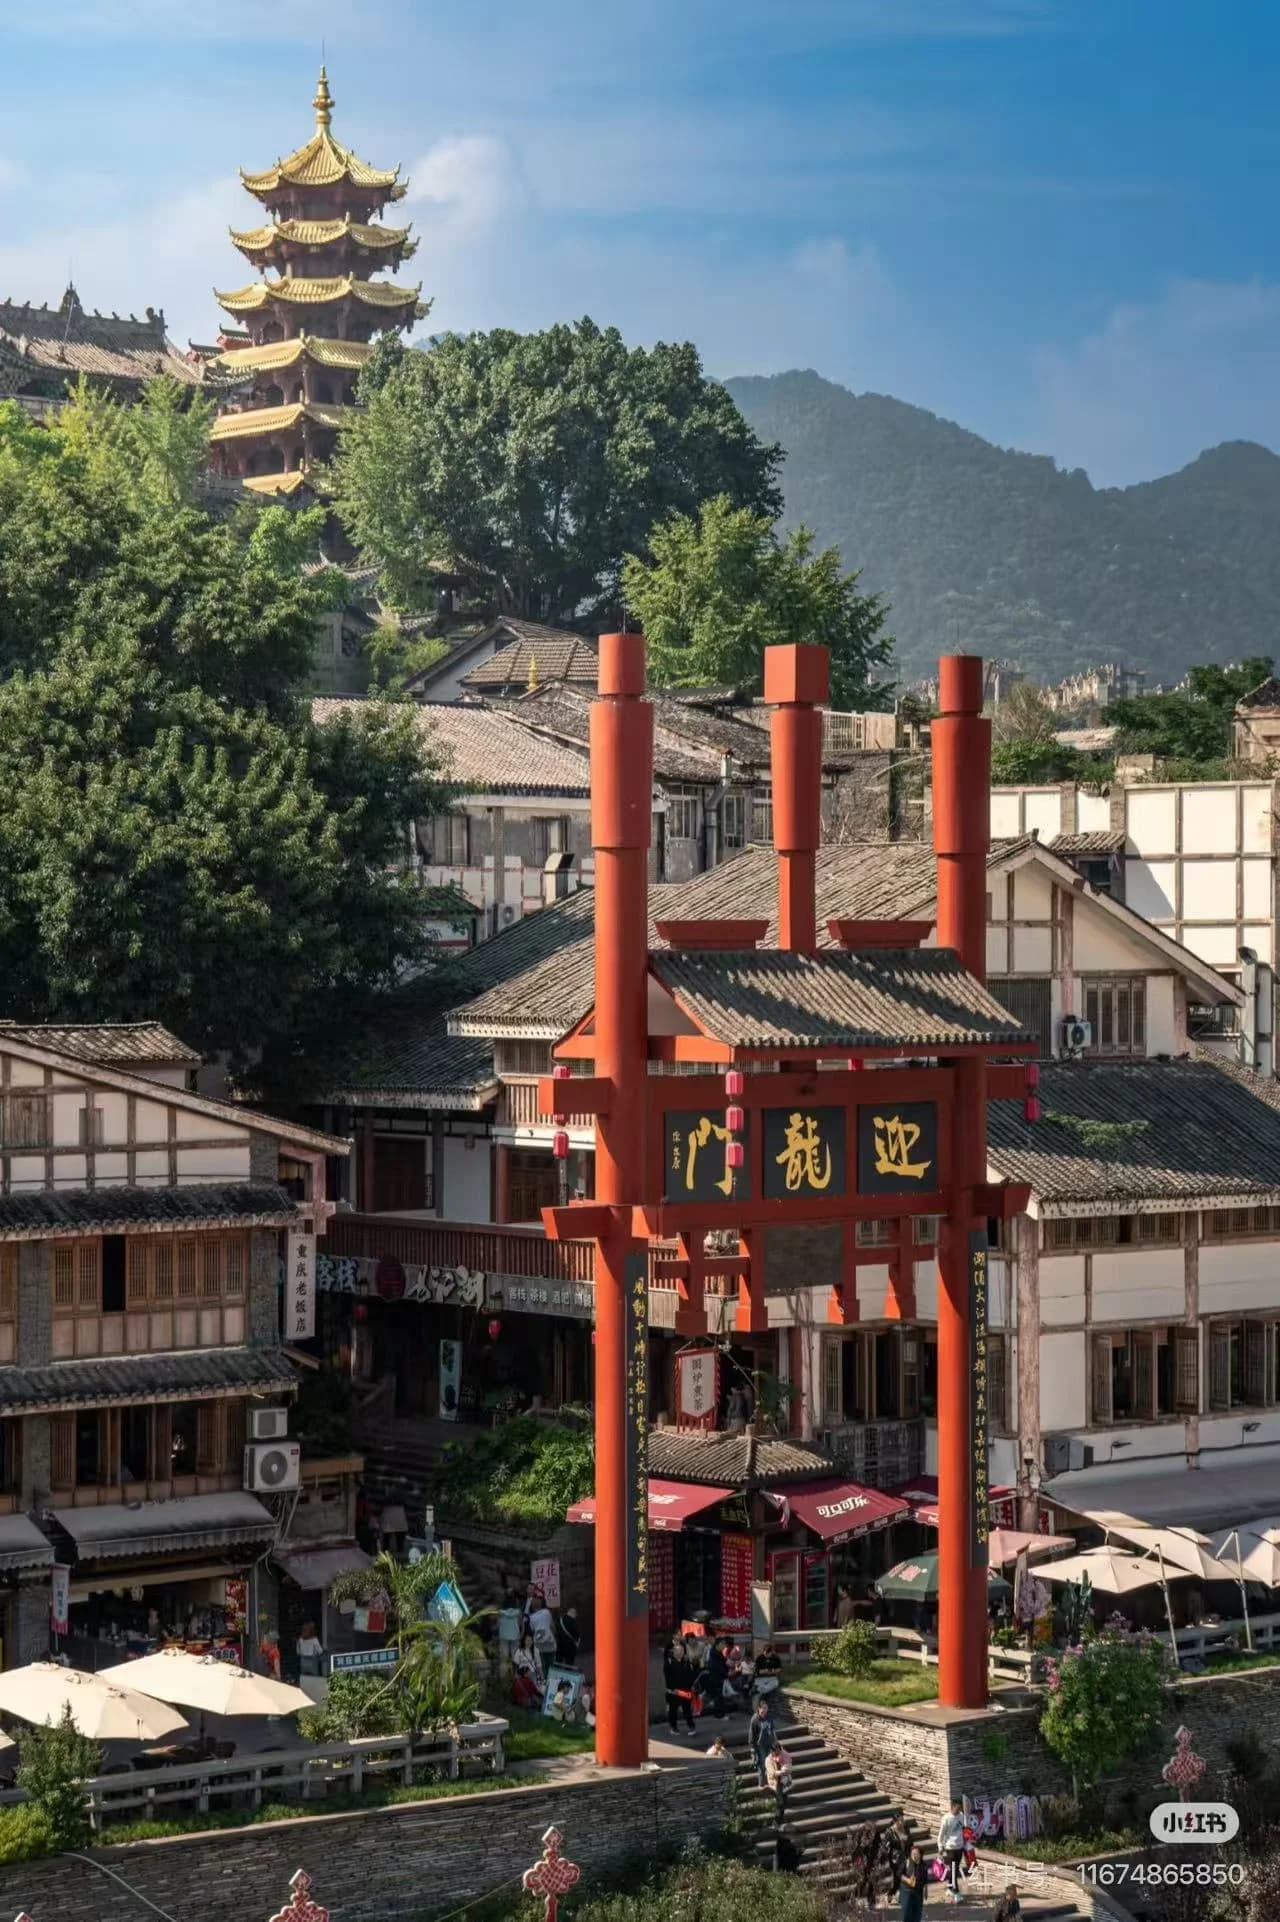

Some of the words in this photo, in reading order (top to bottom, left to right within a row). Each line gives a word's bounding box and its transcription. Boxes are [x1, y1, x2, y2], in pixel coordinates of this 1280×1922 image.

[295, 1243, 307, 1332] 重庆老饭店
[816, 1495, 870, 1518] 可口可乐
[535, 1563, 558, 1579] 豆花
